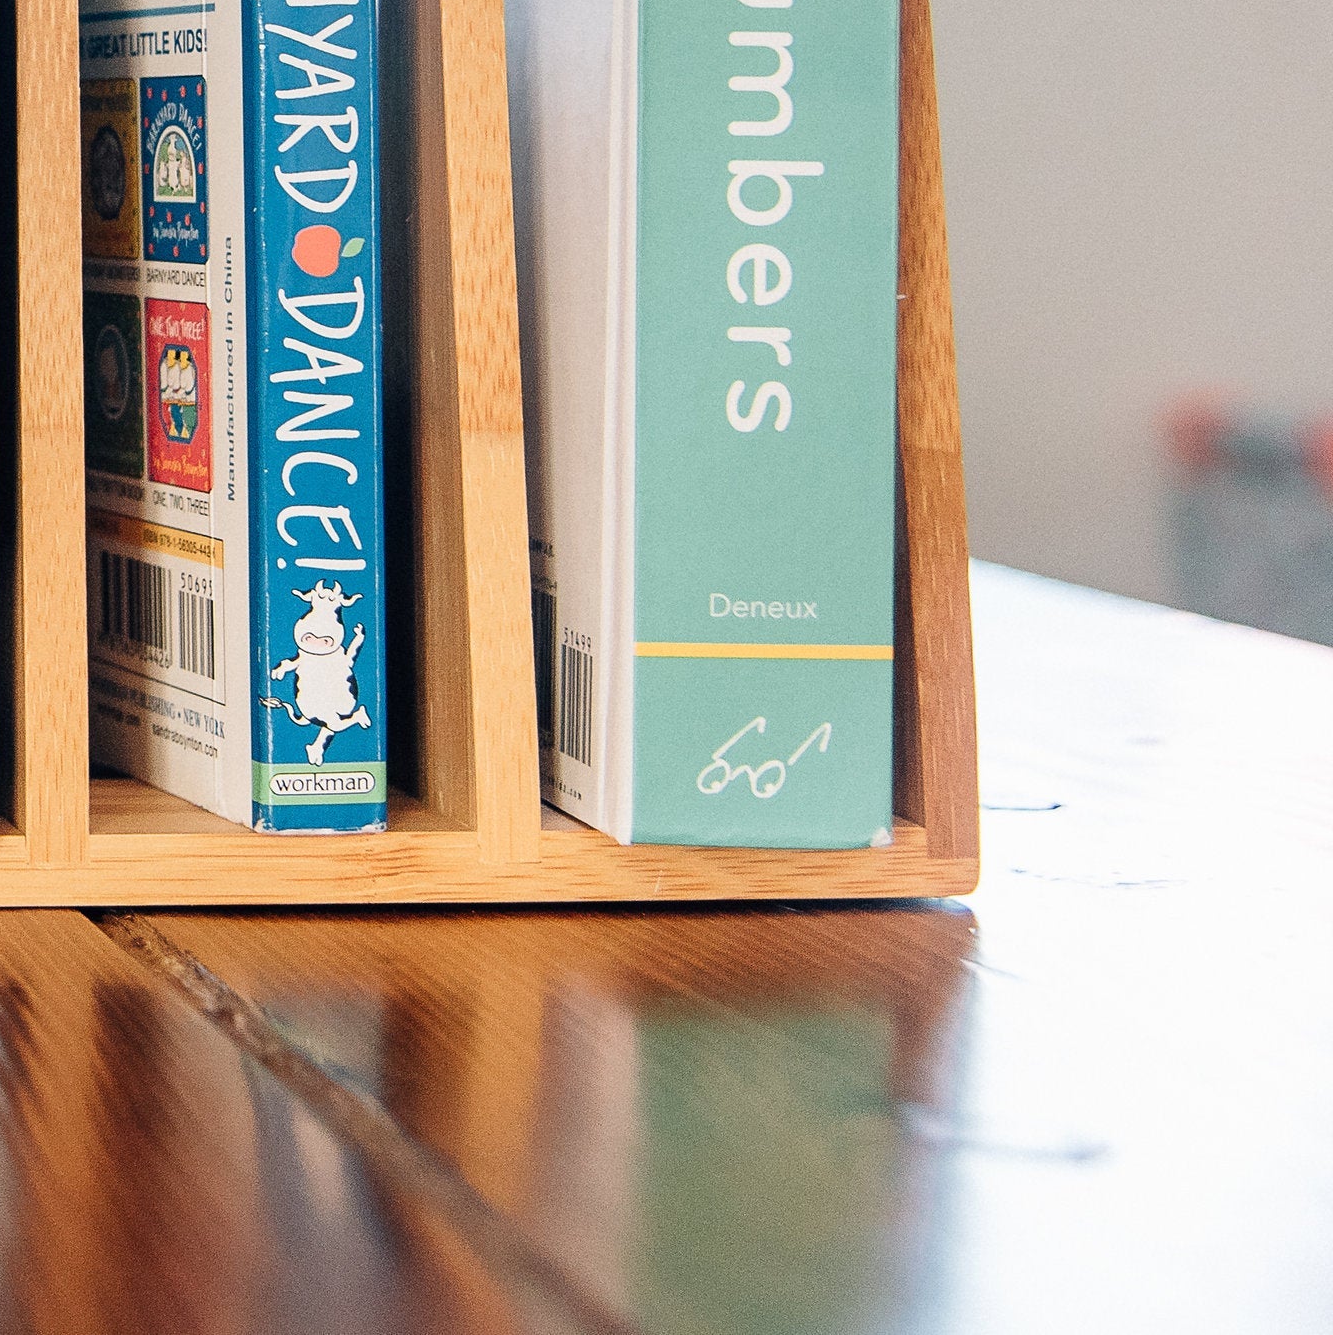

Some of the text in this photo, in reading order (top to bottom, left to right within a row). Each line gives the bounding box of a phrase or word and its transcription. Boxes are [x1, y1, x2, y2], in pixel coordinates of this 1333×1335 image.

[129, 30, 170, 56] LITTLE
[173, 28, 208, 54] KIDS!
[224, 236, 236, 501] Manufactured in China
[269, 276, 367, 571] DANCE!
[709, 593, 818, 620] Deneux
[183, 708, 201, 728] NEW
[203, 714, 226, 739] YORK
[275, 773, 369, 792] workman
